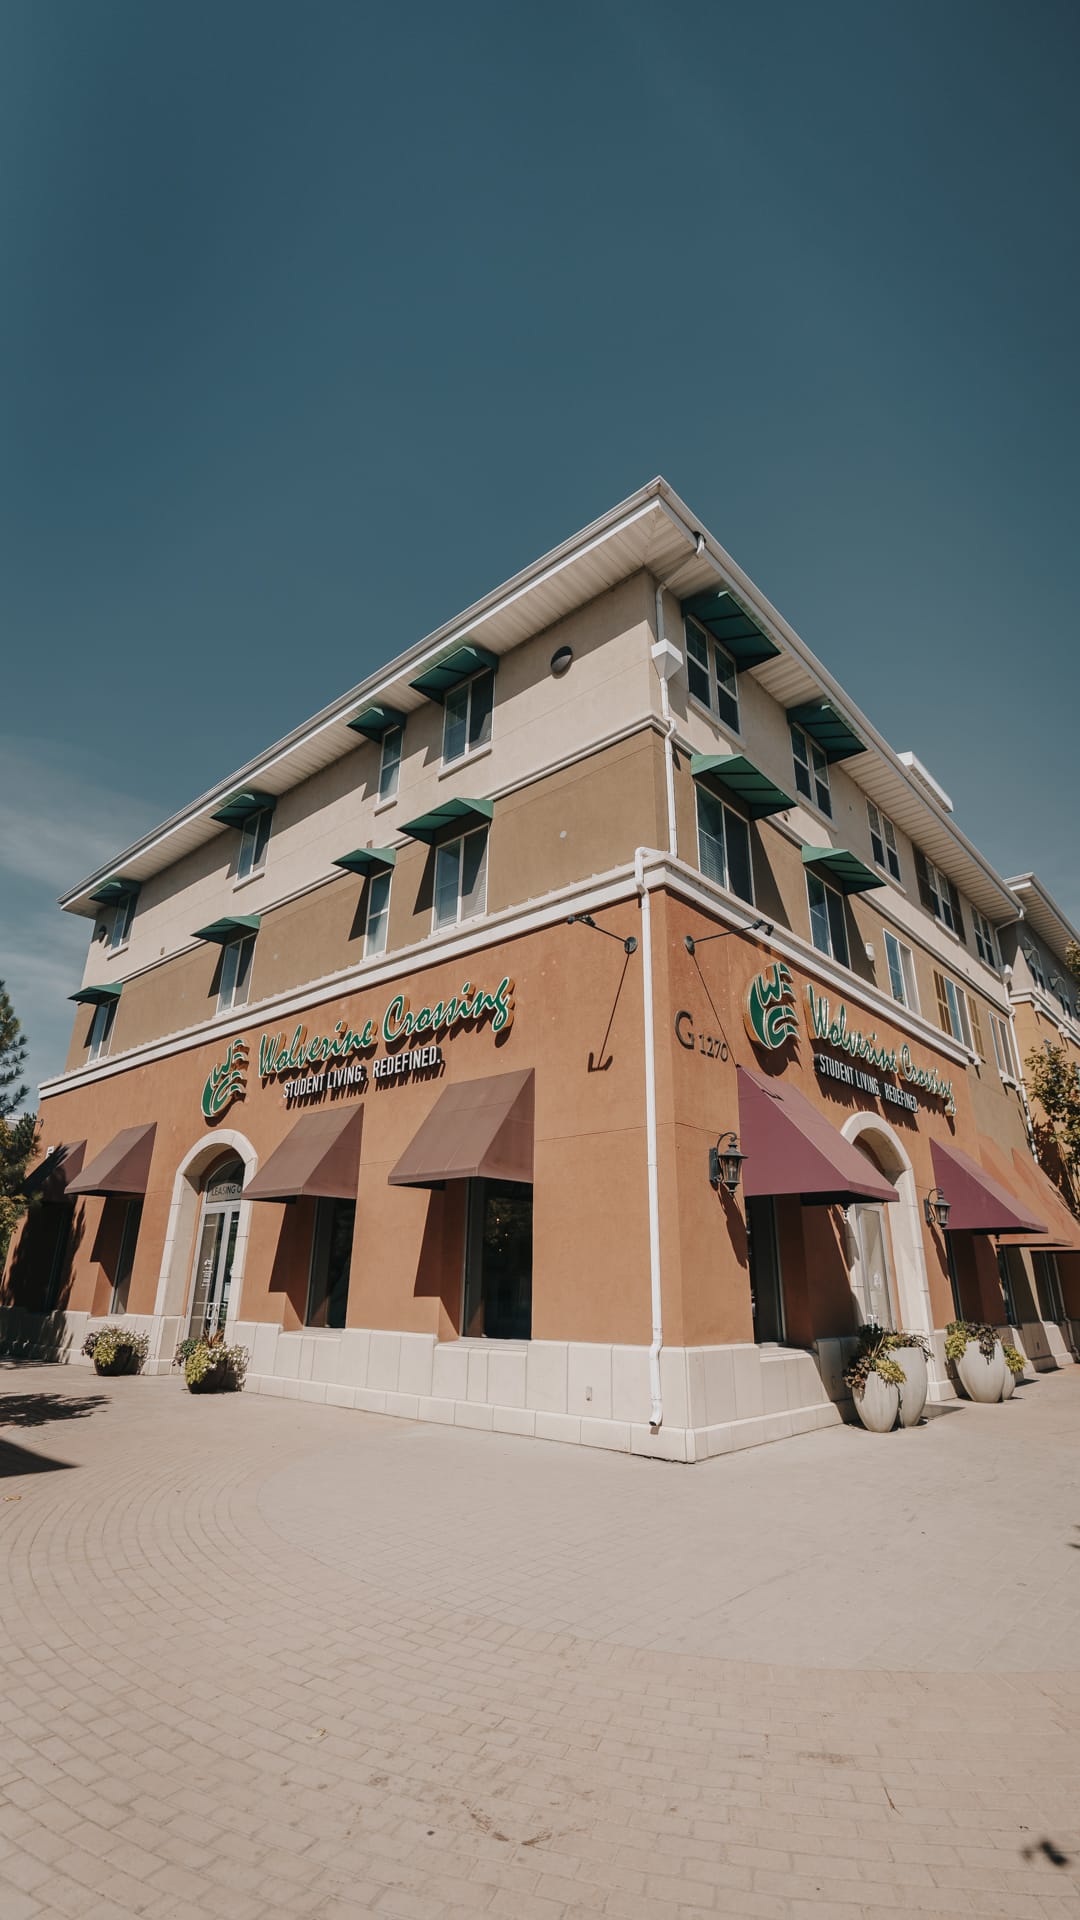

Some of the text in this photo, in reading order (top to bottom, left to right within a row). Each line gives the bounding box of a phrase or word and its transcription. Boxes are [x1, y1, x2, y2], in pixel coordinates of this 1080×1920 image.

[258, 976, 511, 1078] Wolverine Crossing
[806, 984, 956, 1117] Wolverine Crossing
[283, 1045, 441, 1098] STUDENT LIVING. REDEFINED.
[819, 1054, 855, 1086] STUDENT
[212, 1184, 236, 1196] LEASING
